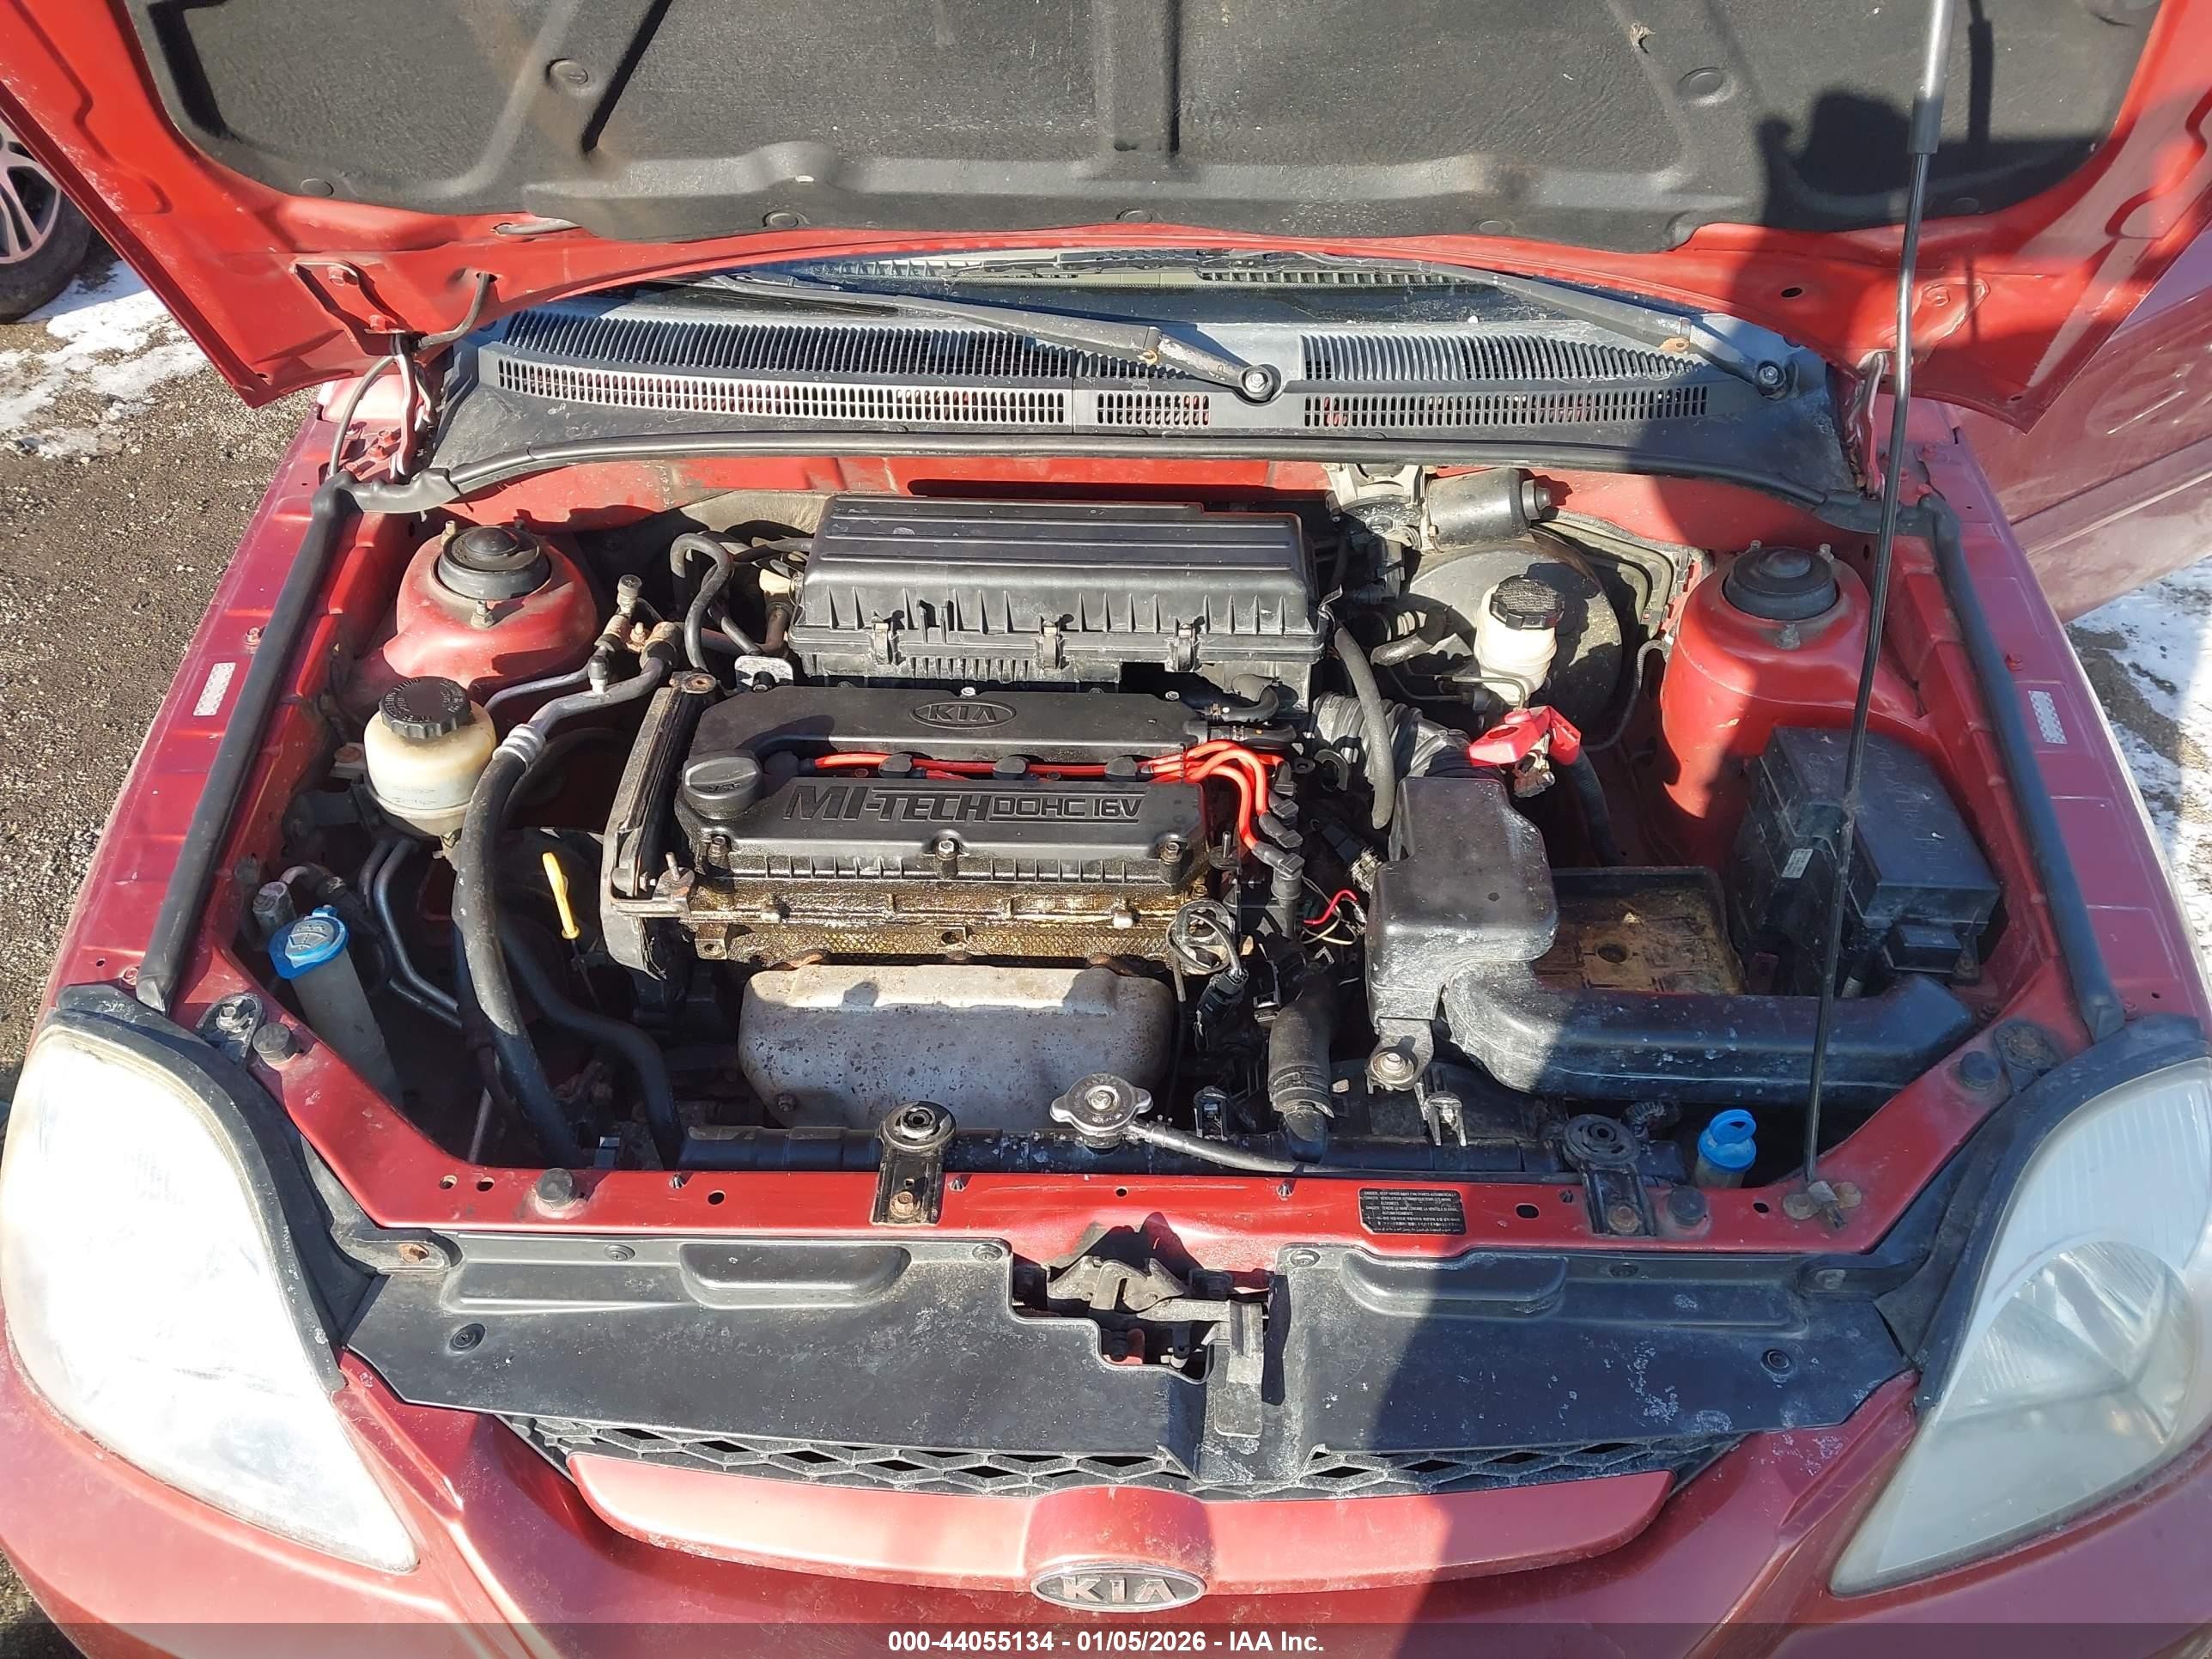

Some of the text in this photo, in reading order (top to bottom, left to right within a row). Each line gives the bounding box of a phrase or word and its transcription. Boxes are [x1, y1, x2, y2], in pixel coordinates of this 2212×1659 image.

[927, 704, 997, 722] KIA
[781, 785, 1145, 823] MI-TECH DOHC 16V
[1060, 1575, 1178, 1603] KIA
